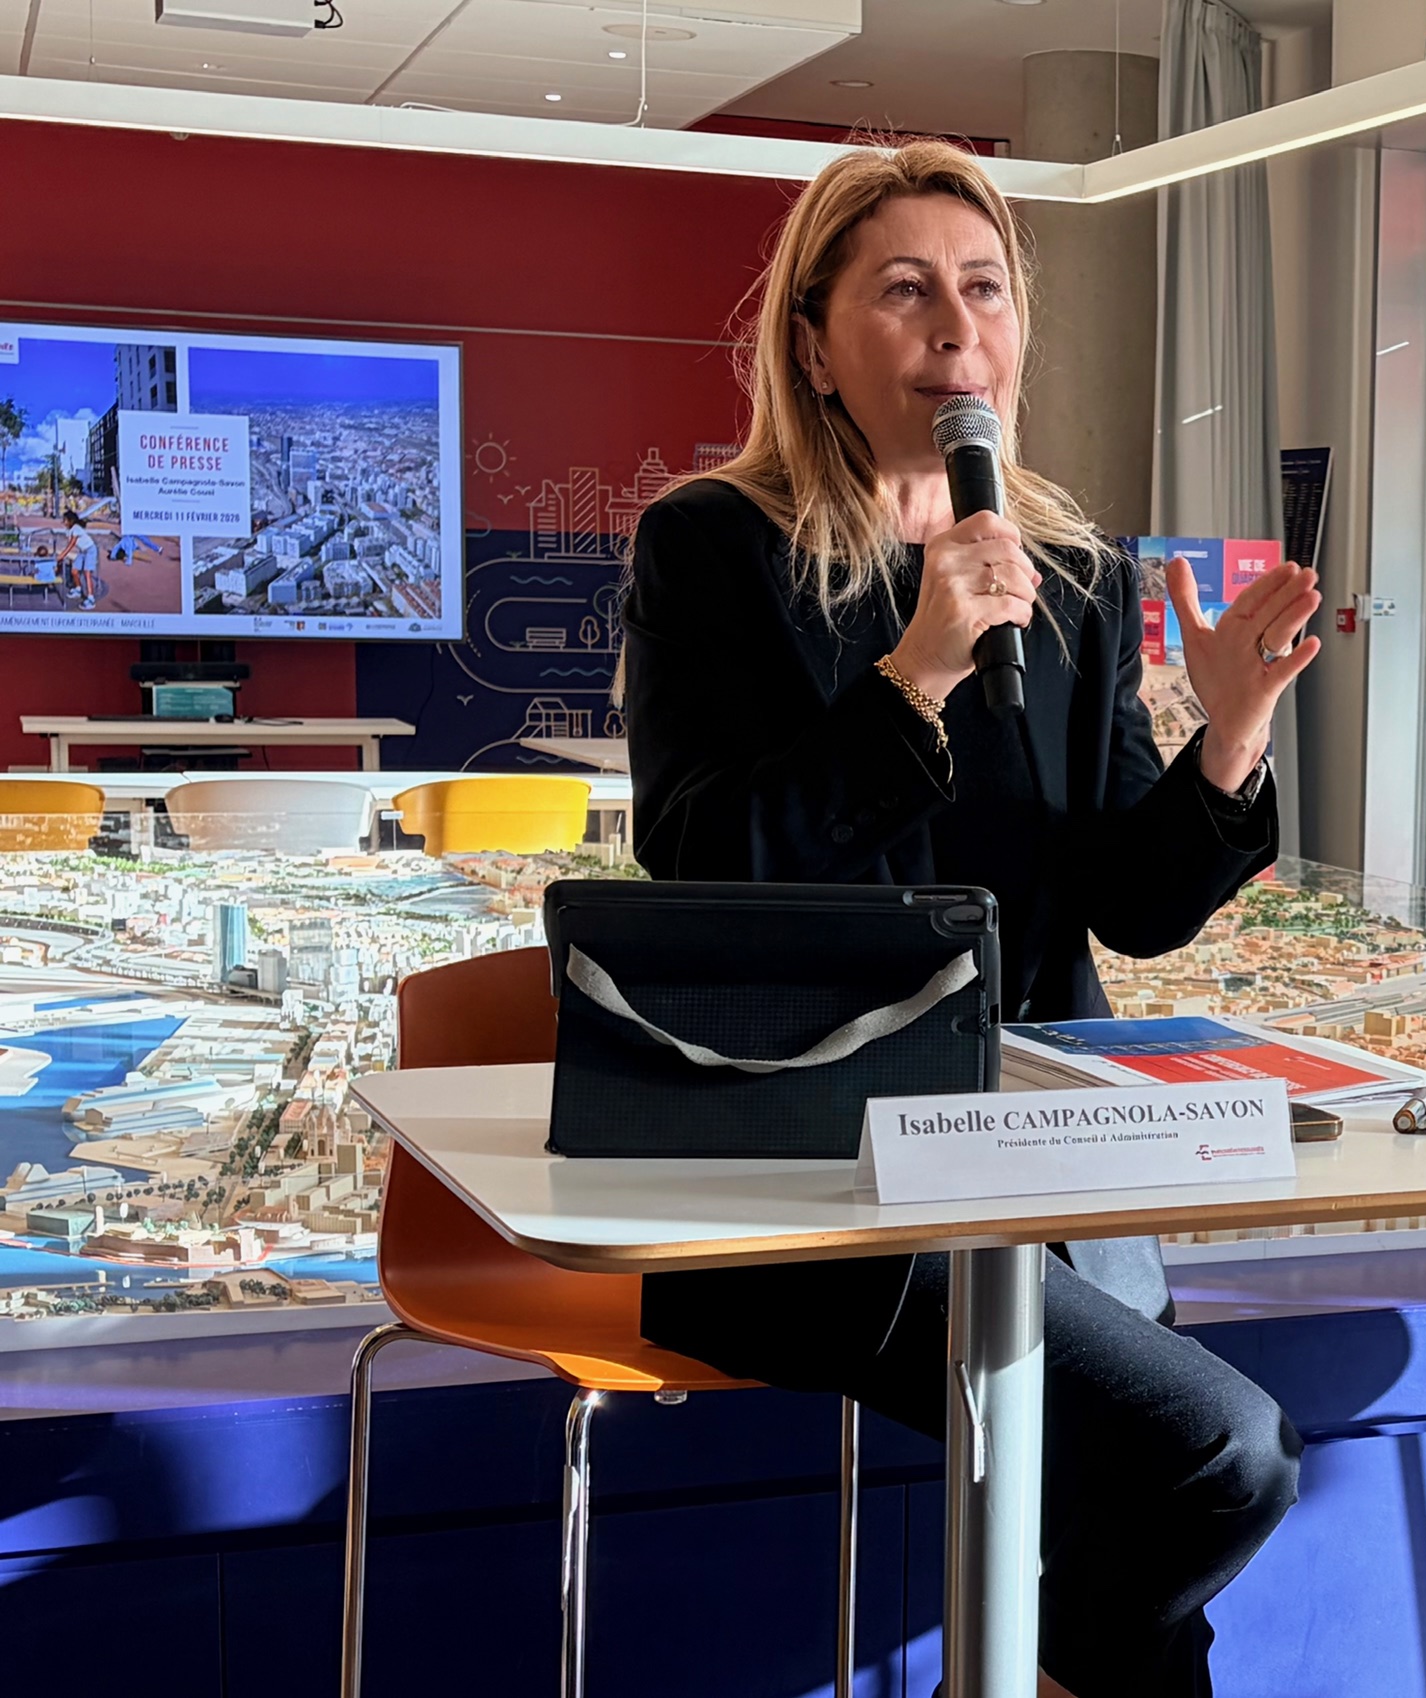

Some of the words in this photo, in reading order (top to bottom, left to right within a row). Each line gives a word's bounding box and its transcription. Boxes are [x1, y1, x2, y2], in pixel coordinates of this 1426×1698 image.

[140, 434, 229, 453] CONFÉRENCE
[148, 454, 164, 469] DE
[171, 455, 222, 471] PRESSE
[133, 510, 173, 521] MERCREDI
[176, 511, 184, 521] 11
[187, 511, 218, 522] FÉVRIER
[898, 1110, 996, 1136] Isabelle
[1003, 1099, 1265, 1130] CAMPAGNOLA-SAVON
[998, 1138, 1047, 1148] Présidente
[1049, 1137, 1061, 1146] du
[1064, 1134, 1098, 1144] Conseil
